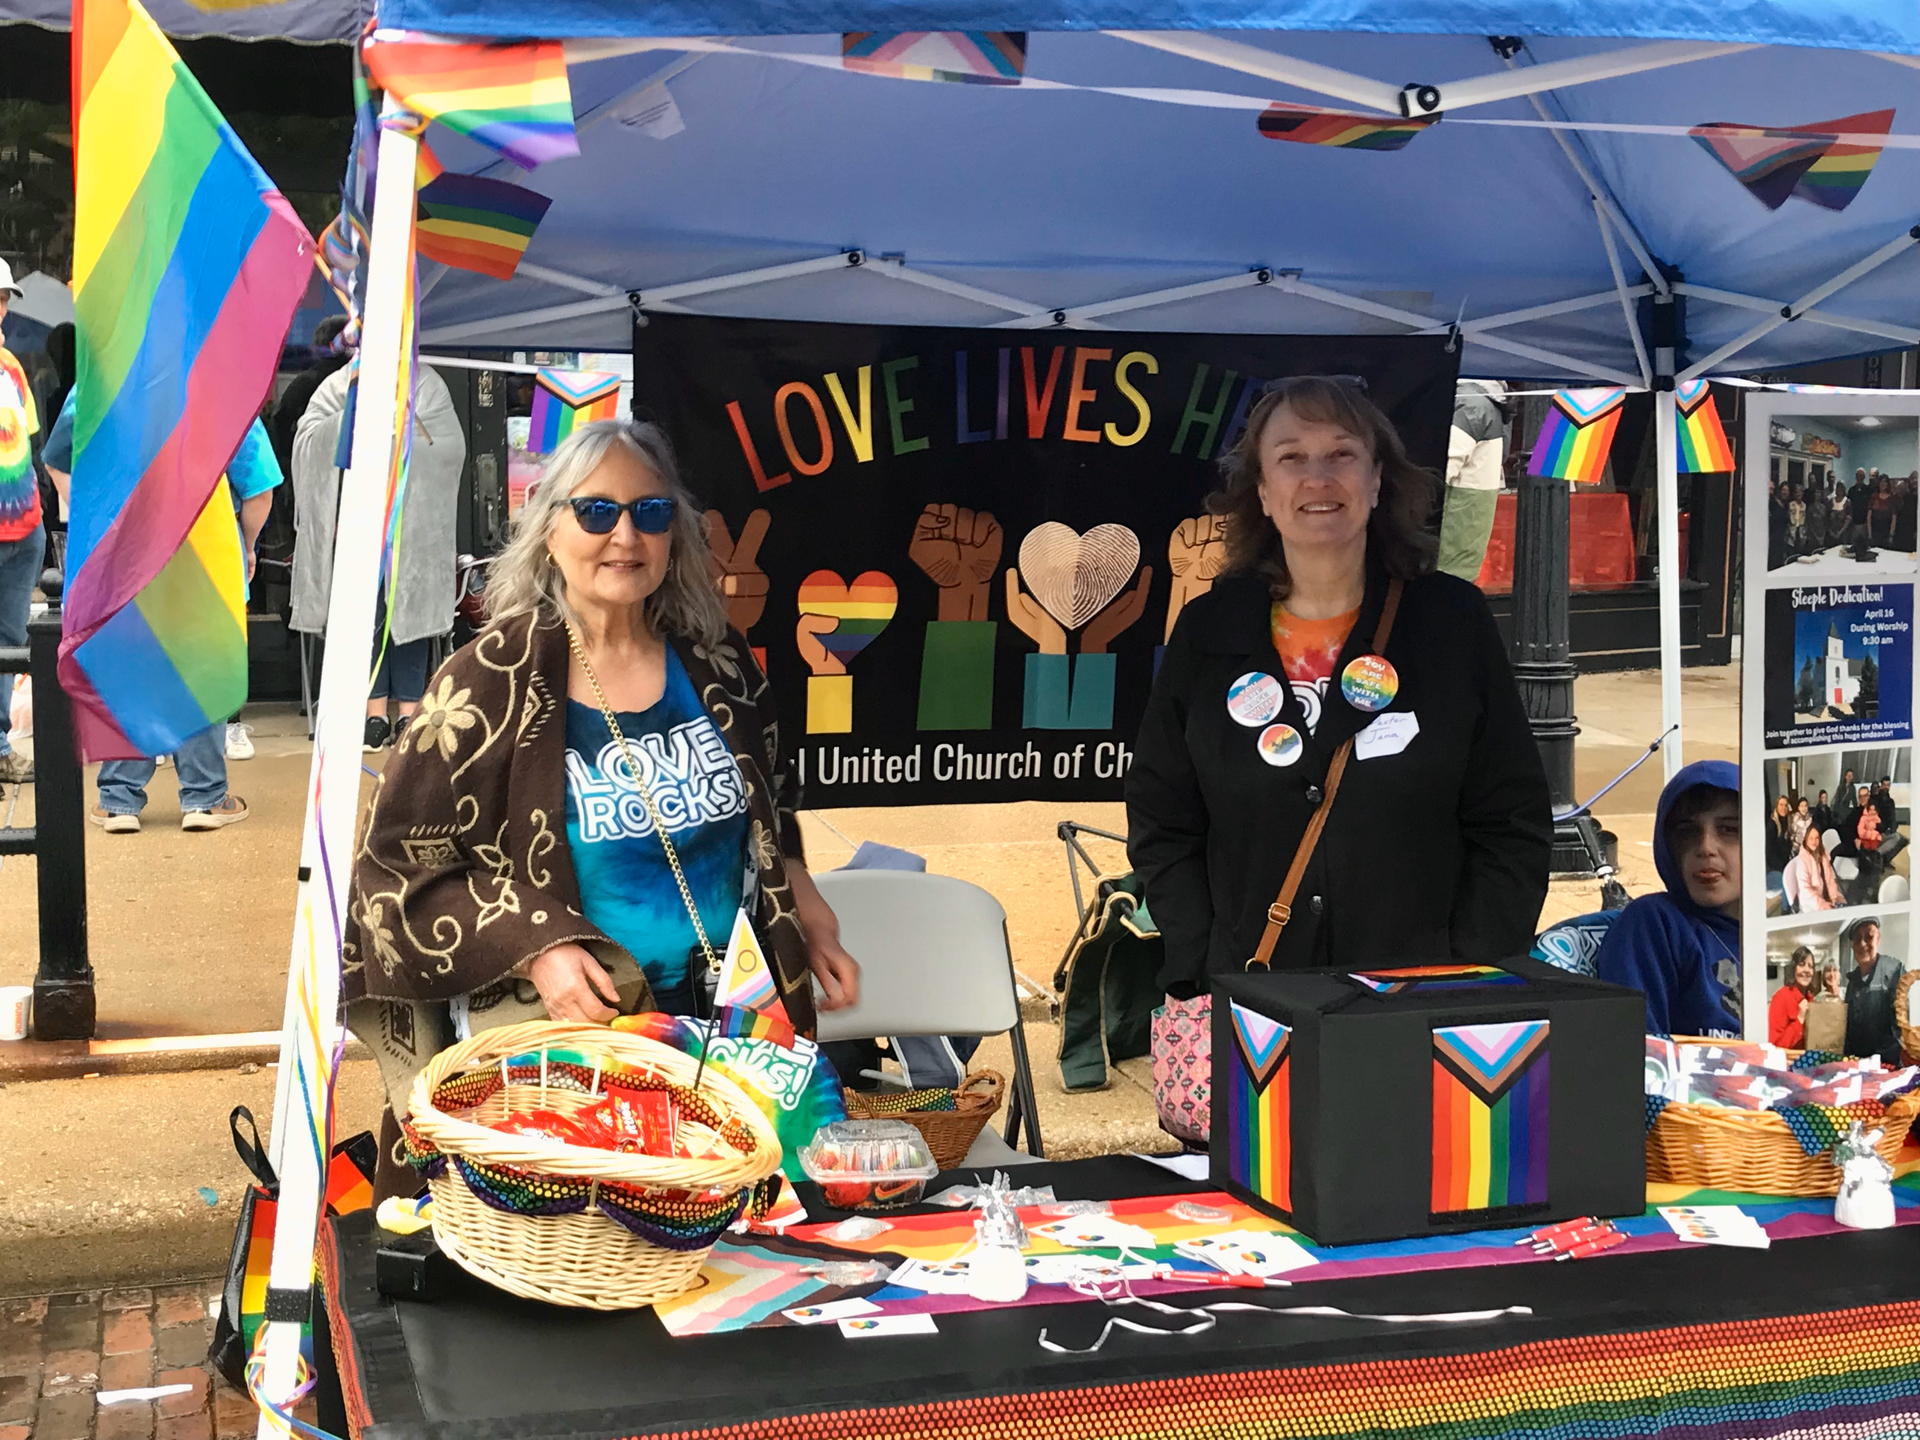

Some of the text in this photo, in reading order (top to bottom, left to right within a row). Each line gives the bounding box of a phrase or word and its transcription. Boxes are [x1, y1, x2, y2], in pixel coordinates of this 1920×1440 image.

[725, 356, 930, 493] LOVE
[954, 346, 1159, 447] LIVES
[1170, 362, 1265, 462] HE
[1792, 585, 1883, 612] Steeple Dedication!
[1864, 609, 1895, 620] April 16
[1850, 621, 1909, 634] During Worship
[1862, 636, 1894, 646] 9:30 am
[1365, 656, 1386, 671] YOU
[1361, 669, 1383, 680] ARE
[1239, 681, 1258, 695] YOU
[1355, 677, 1382, 690] SAFE
[1351, 685, 1380, 699] WITH
[1248, 699, 1273, 717] WITH
[1354, 696, 1372, 707] ME
[1826, 725, 1839, 733] God
[565, 720, 732, 794] LOVE
[818, 744, 921, 785] United
[933, 741, 1041, 781] Church
[1053, 744, 1085, 779] of
[583, 769, 747, 838] ROCKS!
